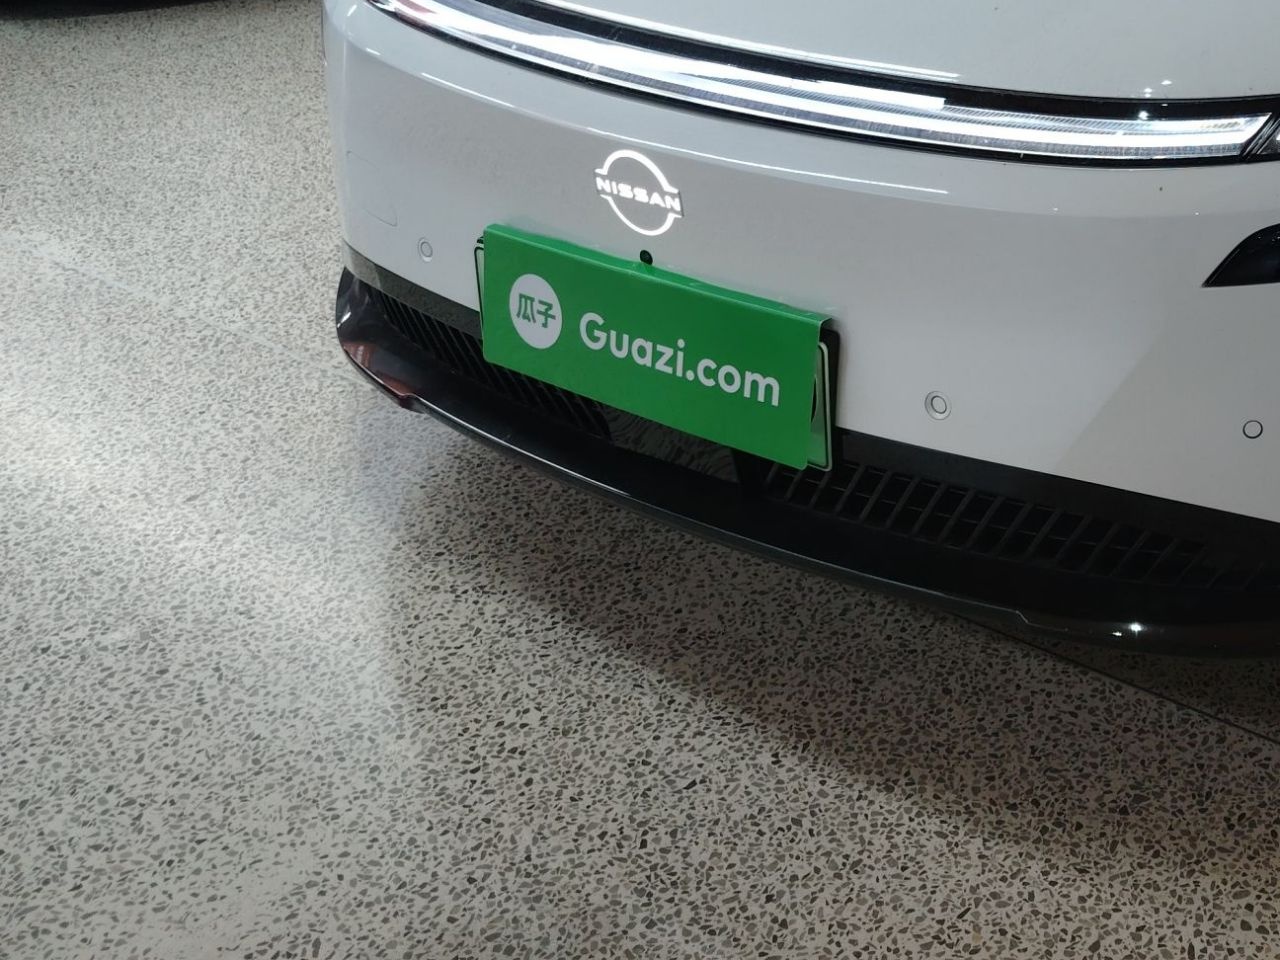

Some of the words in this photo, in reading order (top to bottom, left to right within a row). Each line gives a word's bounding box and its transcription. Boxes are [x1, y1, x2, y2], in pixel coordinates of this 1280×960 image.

[595, 176, 682, 212] NISSAN
[516, 292, 556, 329] 瓜子
[579, 312, 780, 407] Guazi.com
